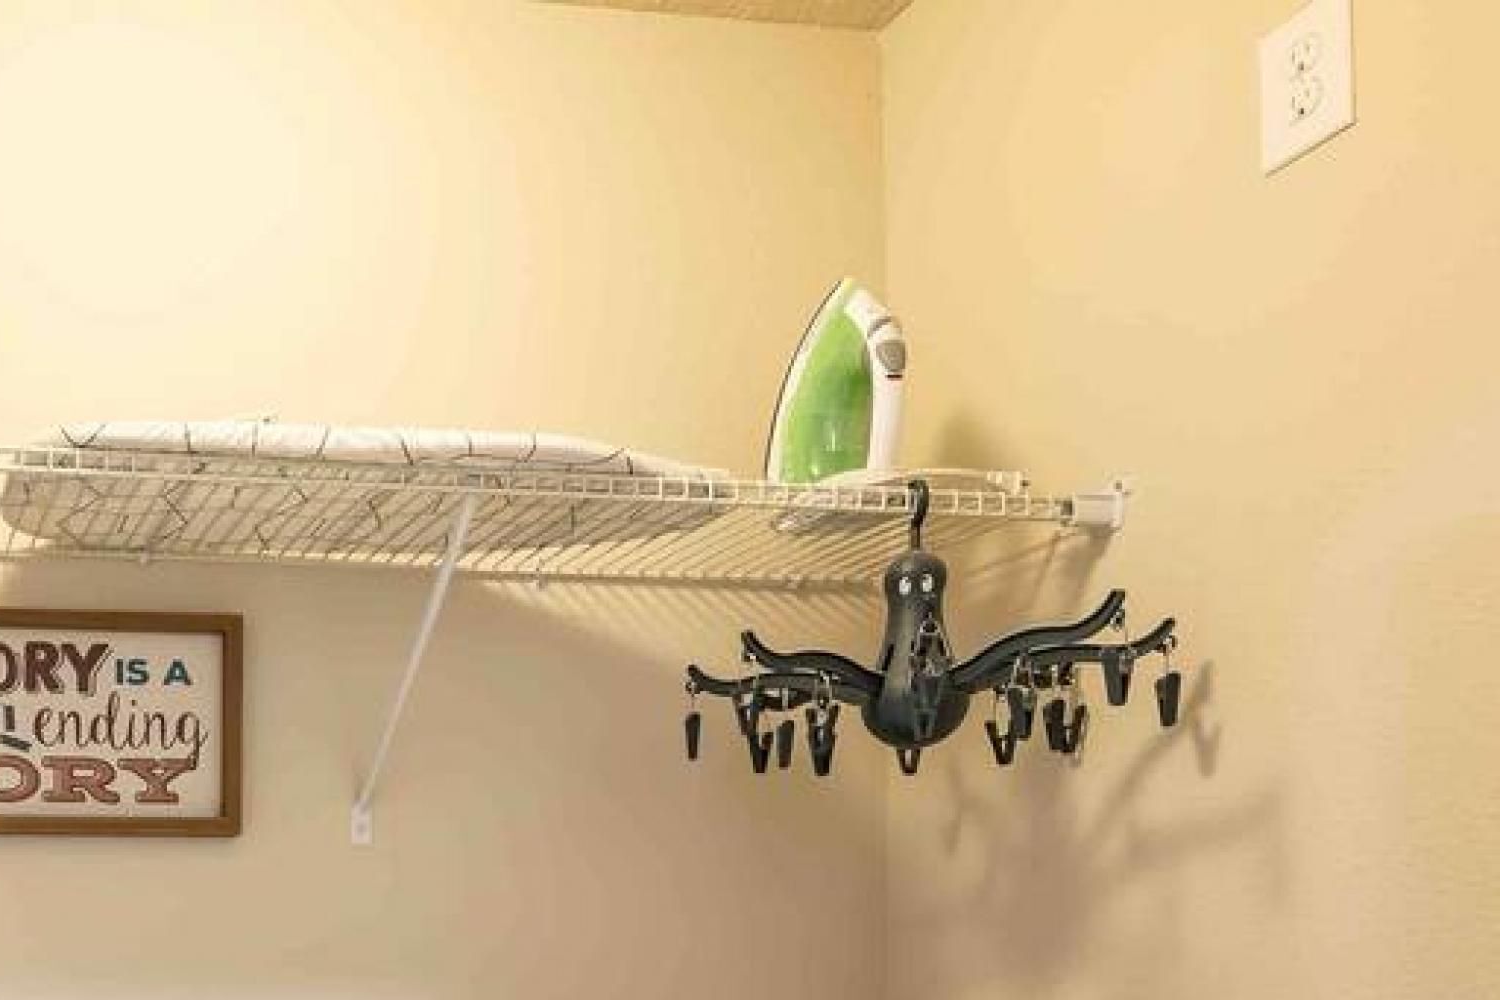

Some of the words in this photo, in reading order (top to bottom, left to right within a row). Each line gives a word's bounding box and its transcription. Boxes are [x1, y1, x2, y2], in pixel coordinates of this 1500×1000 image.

[115, 657, 150, 686] IS
[163, 658, 193, 687] A
[33, 691, 208, 771] ending
